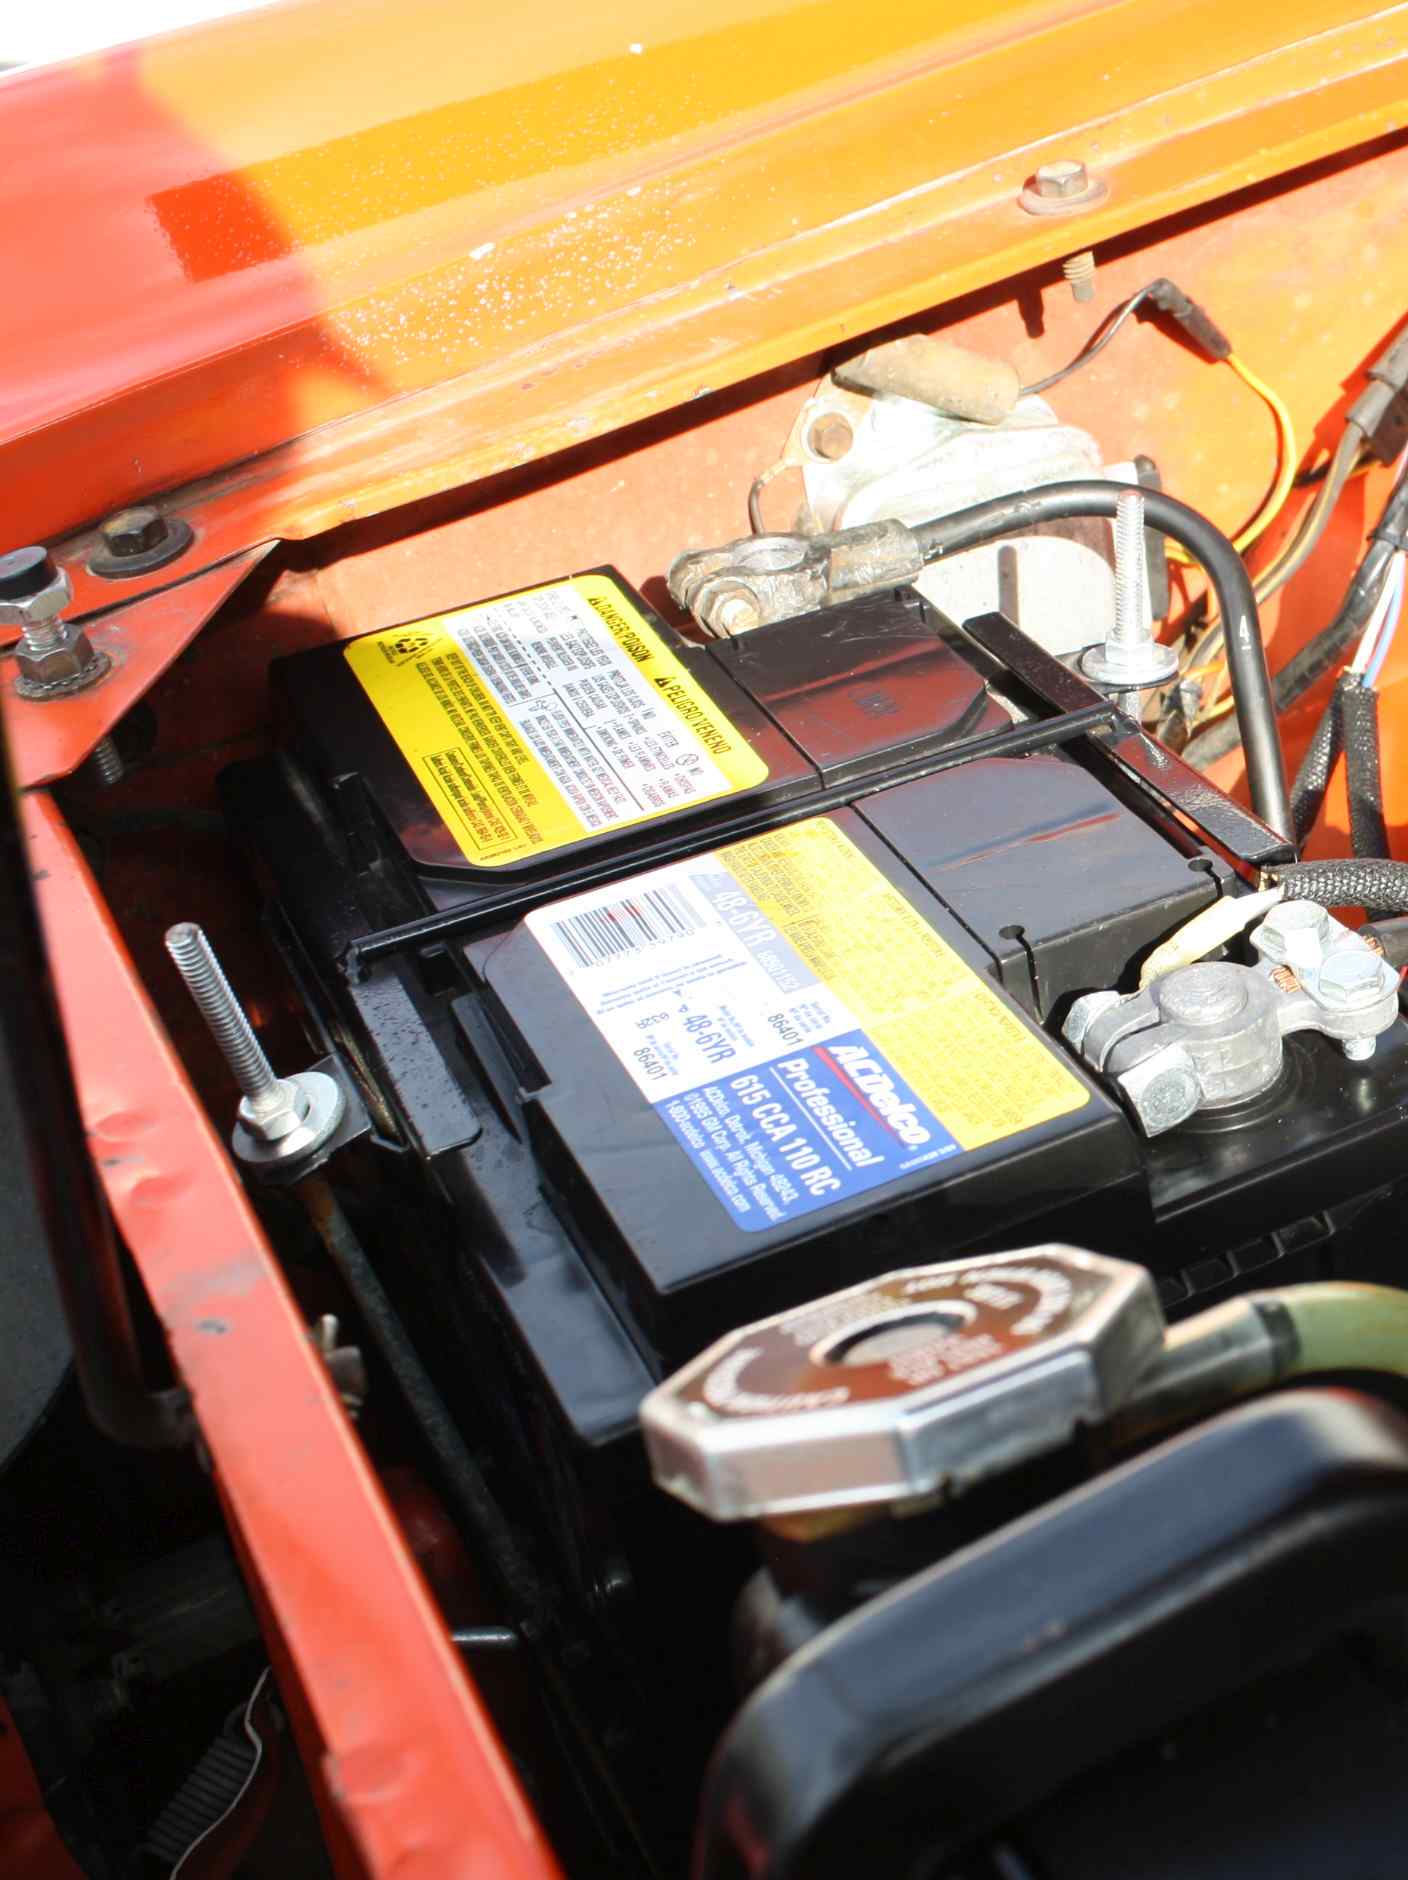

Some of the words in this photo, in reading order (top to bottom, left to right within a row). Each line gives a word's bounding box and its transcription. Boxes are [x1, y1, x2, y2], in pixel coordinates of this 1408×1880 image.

[712, 891, 774, 944] 48-6YR
[683, 1014, 735, 1063] 48-6YR
[767, 1013, 803, 1046] 86401
[633, 1047, 668, 1080] 86401
[730, 1075, 772, 1104] 615
[828, 1043, 931, 1143] ACDelco
[750, 1103, 799, 1140] CCA
[777, 1058, 883, 1168] Professional
[777, 1138, 821, 1169] 110
[800, 1168, 841, 1195] RC
